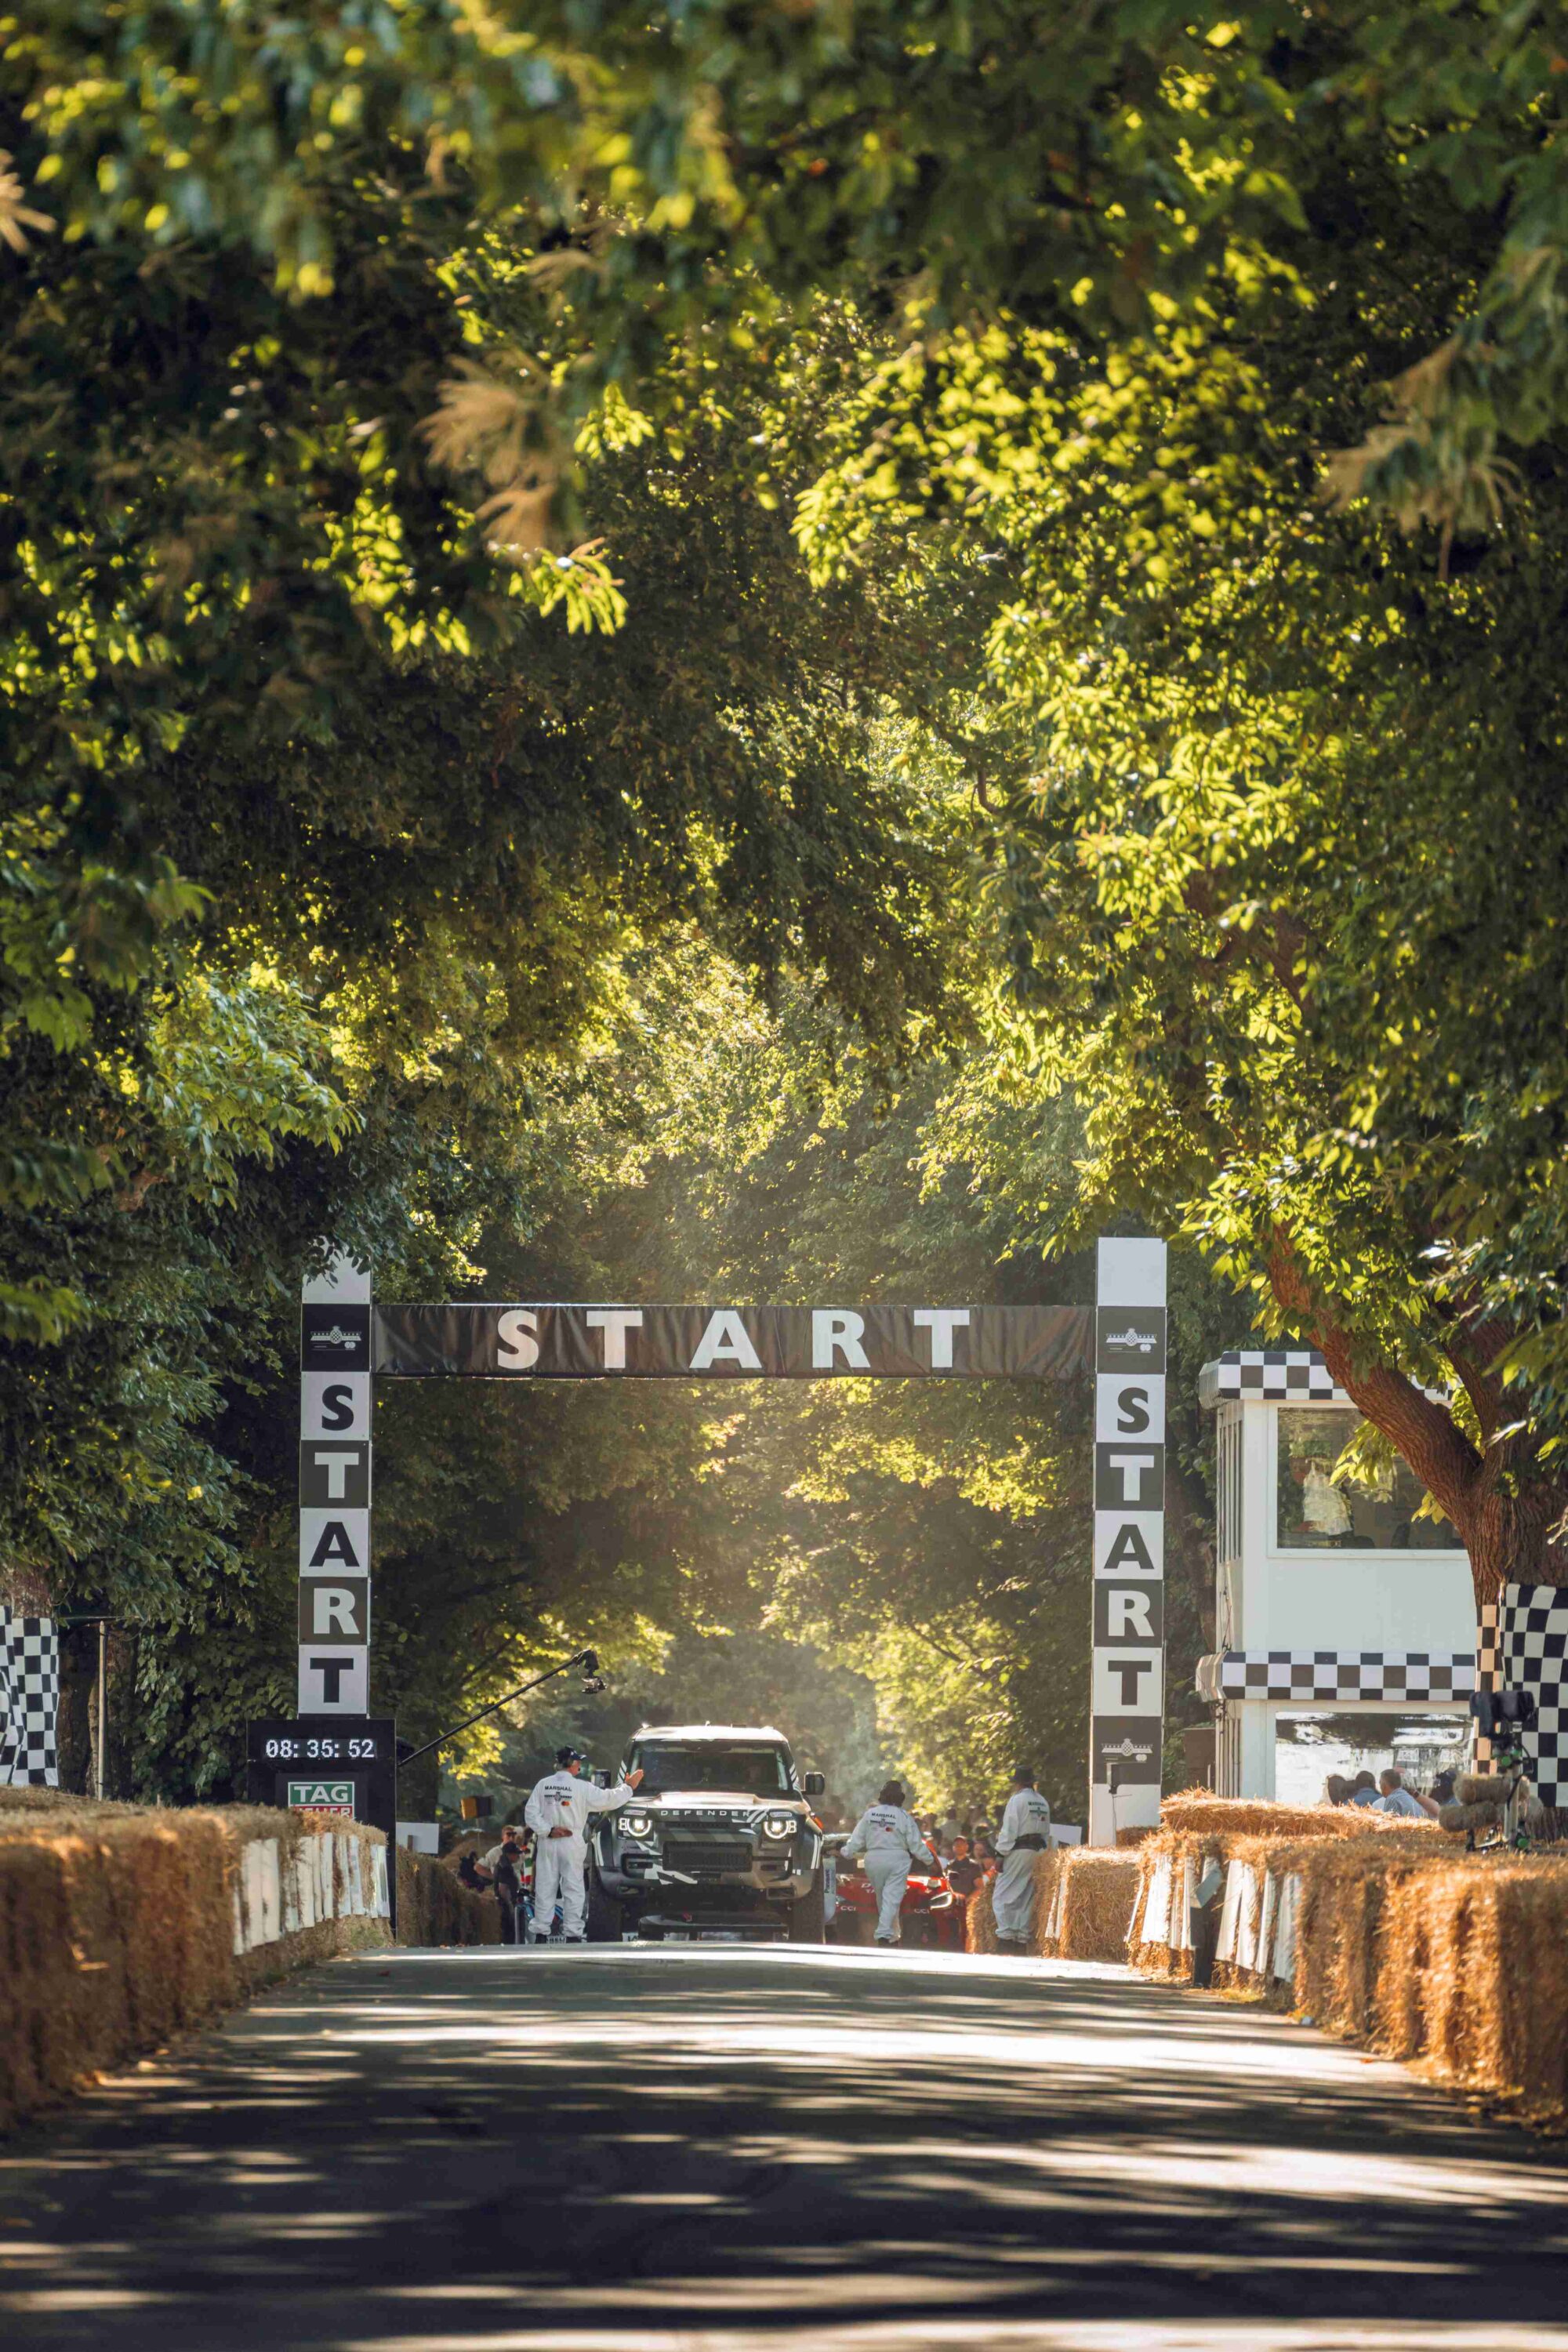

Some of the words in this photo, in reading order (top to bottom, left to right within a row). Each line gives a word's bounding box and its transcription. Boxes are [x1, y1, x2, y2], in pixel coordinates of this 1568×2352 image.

[496, 1309, 970, 1369] START
[309, 1385, 359, 1703] START
[1103, 1387, 1155, 1706] START
[294, 1785, 348, 1802] TAG
